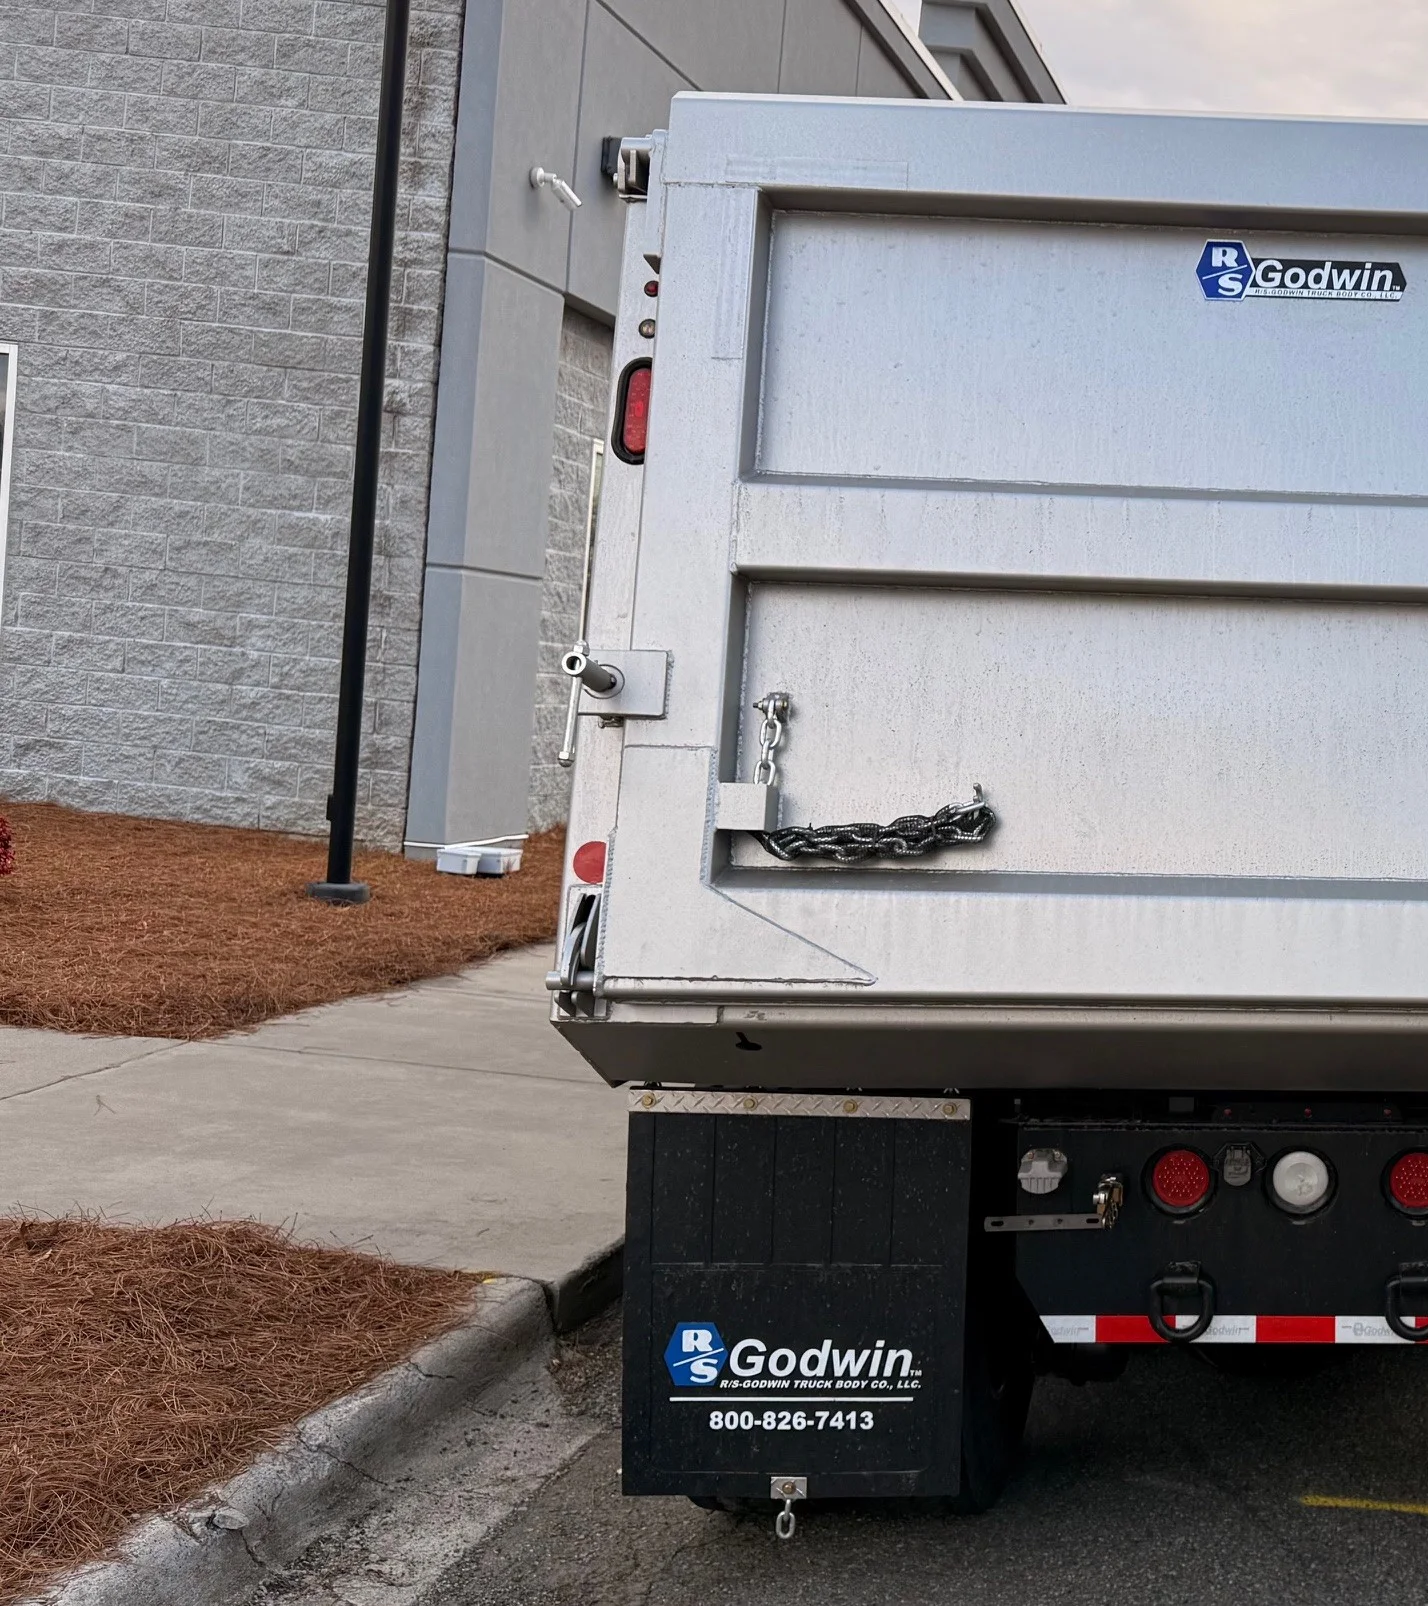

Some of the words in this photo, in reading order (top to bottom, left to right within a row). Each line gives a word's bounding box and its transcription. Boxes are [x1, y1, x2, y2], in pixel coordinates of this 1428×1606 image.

[1255, 259, 1393, 291] Godwin
[729, 1338, 913, 1378] Godwin
[719, 1379, 790, 1389] R/S-GODWIN
[793, 1379, 833, 1389] TRUCK
[835, 1379, 869, 1389] BODY
[896, 1379, 922, 1389] LLC.
[709, 1410, 875, 1431] 800-826-7413
